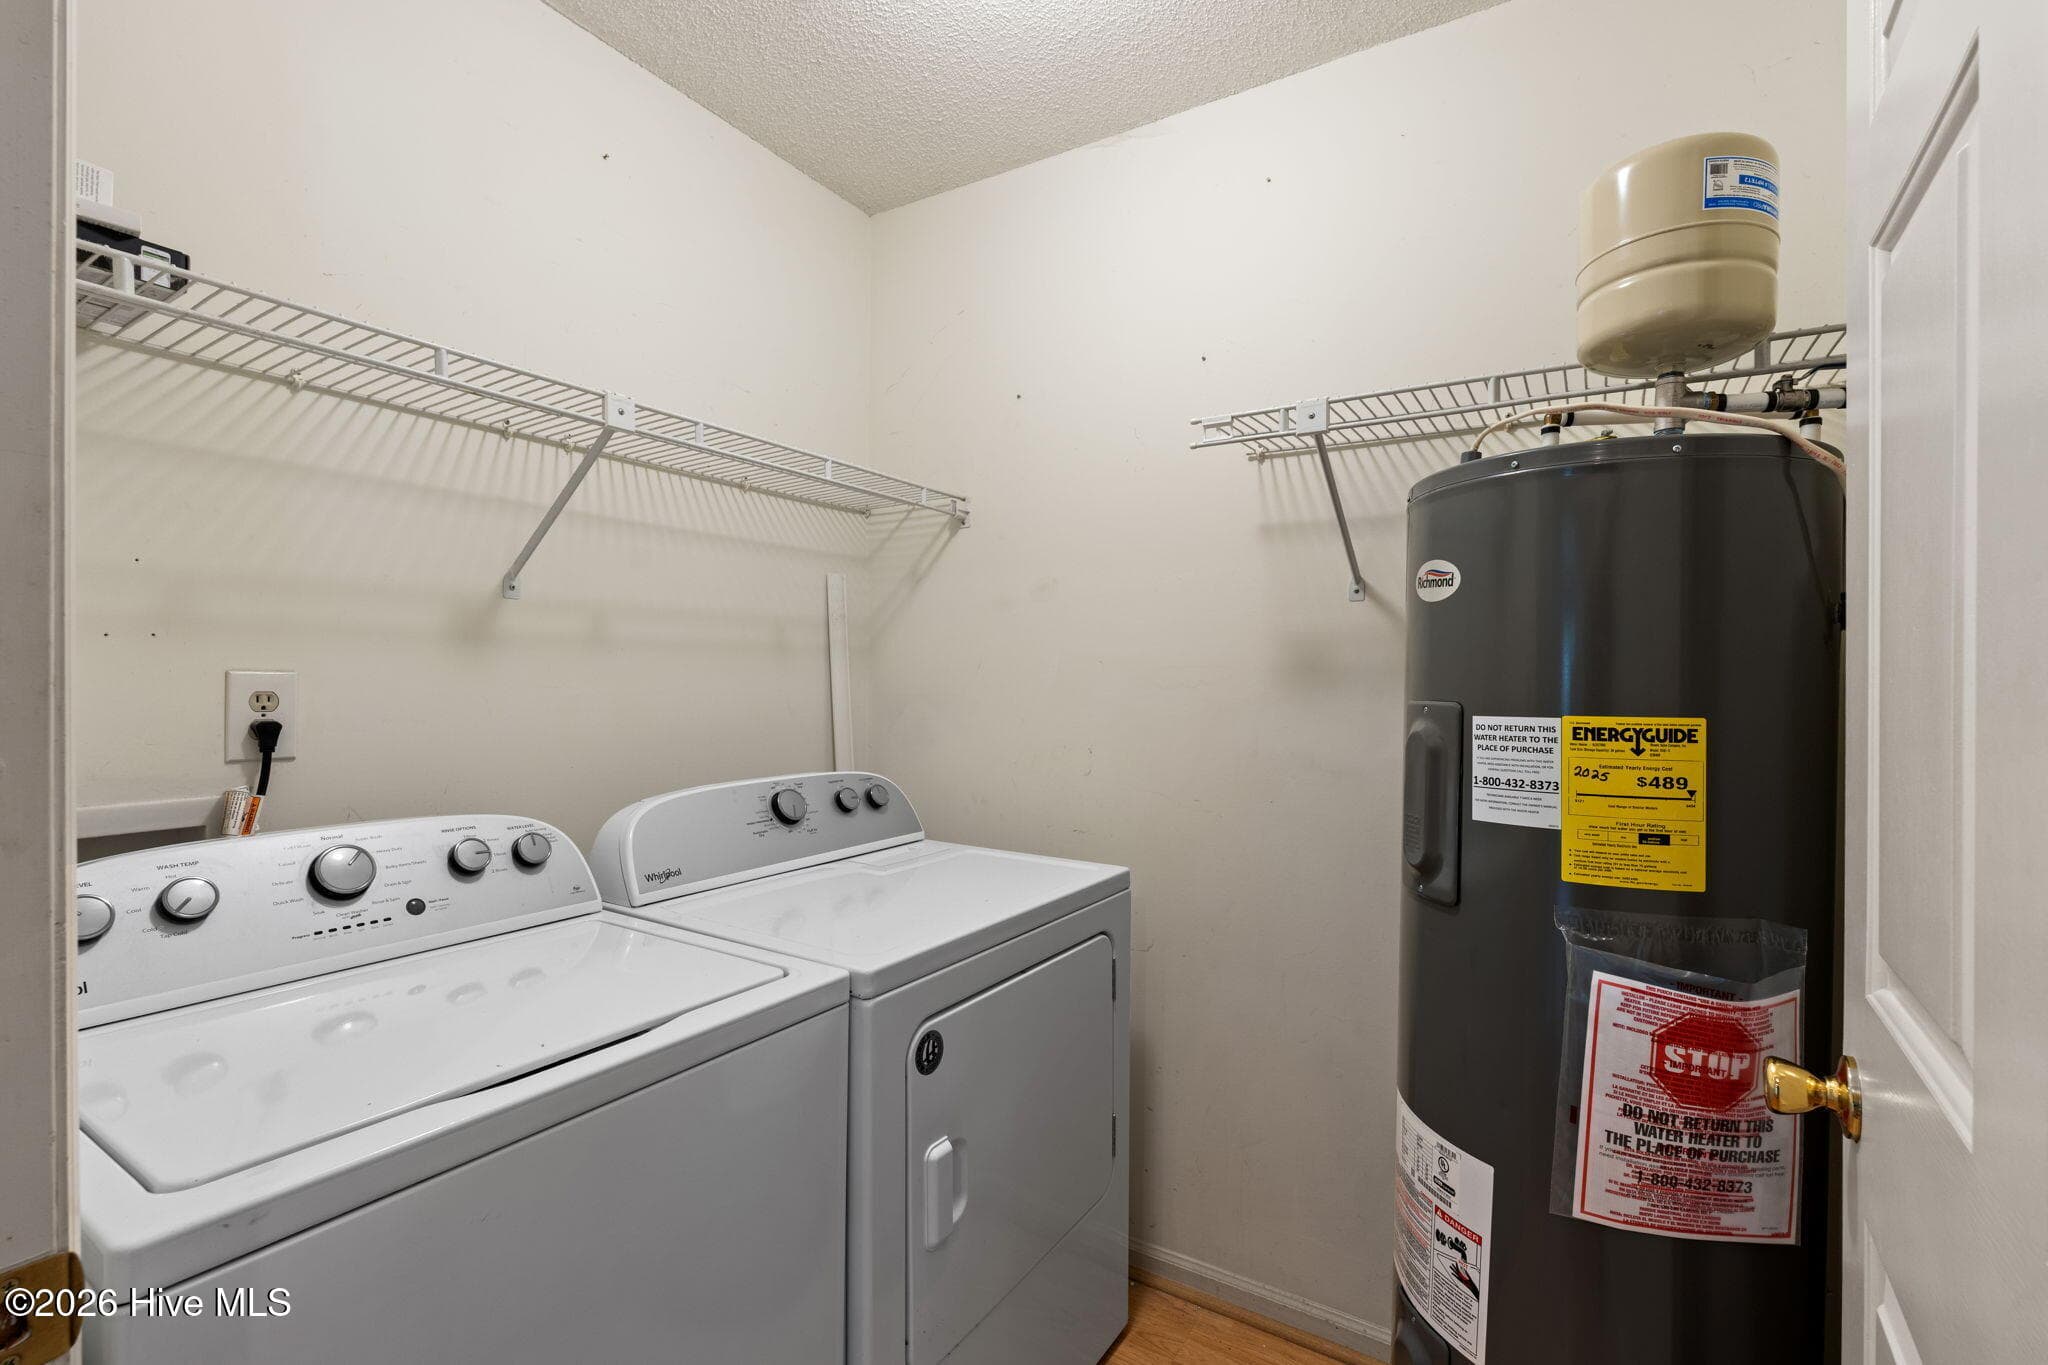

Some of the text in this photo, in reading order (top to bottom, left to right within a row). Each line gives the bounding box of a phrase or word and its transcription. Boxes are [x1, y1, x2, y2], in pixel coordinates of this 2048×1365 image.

[1418, 572, 1454, 589] Richmond
[1487, 724, 1502, 732] NOT
[1504, 725, 1535, 733] RETURN
[1537, 726, 1556, 734] THIS
[1572, 726, 1699, 745] ENERGYGUIDE
[1474, 734, 1497, 742] WATER
[1499, 735, 1527, 743] HEATER
[1529, 736, 1540, 744] TO
[1477, 744, 1498, 752] PLACE
[1511, 746, 1554, 755] PURCHASE
[1574, 765, 1610, 782] 2025
[1473, 776, 1559, 791] 1-800-432-8373
[1636, 776, 1689, 790] $489
[320, 833, 344, 841] Normal
[156, 860, 200, 871] WASH TEMP
[644, 868, 682, 884] Whirlpool
[173, 929, 188, 937] Cold
[1656, 988, 1673, 996] POUCH
[1675, 981, 1737, 1001] IMPORTANT
[1621, 991, 1645, 1001] INSTALLER
[1649, 998, 1666, 1006] PLEASE
[1666, 1001, 1681, 1009] LEAVE
[1664, 1044, 1751, 1081] STOP
[1669, 1060, 1727, 1077] IMPORTANT
[1622, 1103, 1774, 1133] DO NOT RETURN THIS
[1634, 1122, 1762, 1148] WATER HEATER TO
[1604, 1129, 1781, 1163] THE PLACE OF PURCHASE
[1637, 1171, 1753, 1193] 1-800-432-8373
[1444, 1215, 1480, 1243] DANGER
